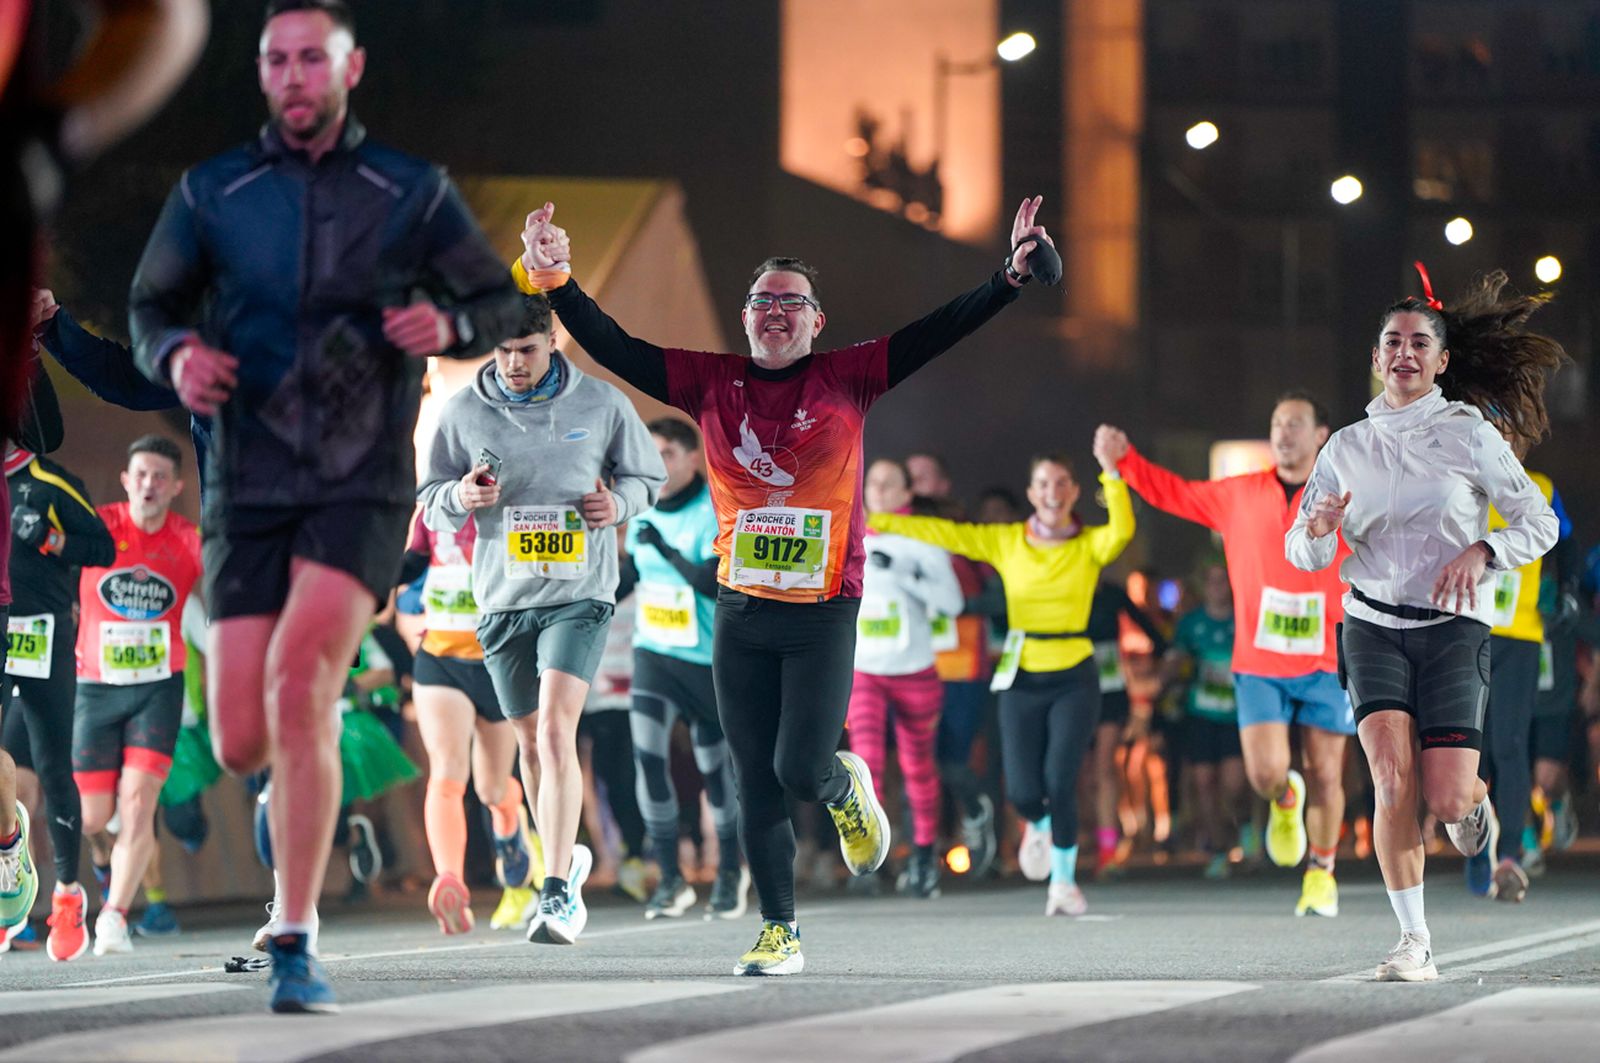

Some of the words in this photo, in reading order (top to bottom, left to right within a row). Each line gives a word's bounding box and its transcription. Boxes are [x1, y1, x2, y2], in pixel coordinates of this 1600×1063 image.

[750, 458, 773, 477] 43
[523, 514, 547, 522] NOCHE
[549, 513, 559, 521] DE
[756, 515, 784, 525] NOCHE
[785, 517, 796, 526] DE
[514, 523, 530, 531] SAN
[532, 521, 559, 531] ANTÓN
[744, 524, 763, 533] SAN
[764, 525, 796, 536] ANTÓN
[520, 532, 574, 554] 5380
[753, 535, 808, 563] 9172
[765, 562, 792, 570] Fernando
[110, 576, 168, 599] Estrella
[111, 592, 163, 610] Galicia
